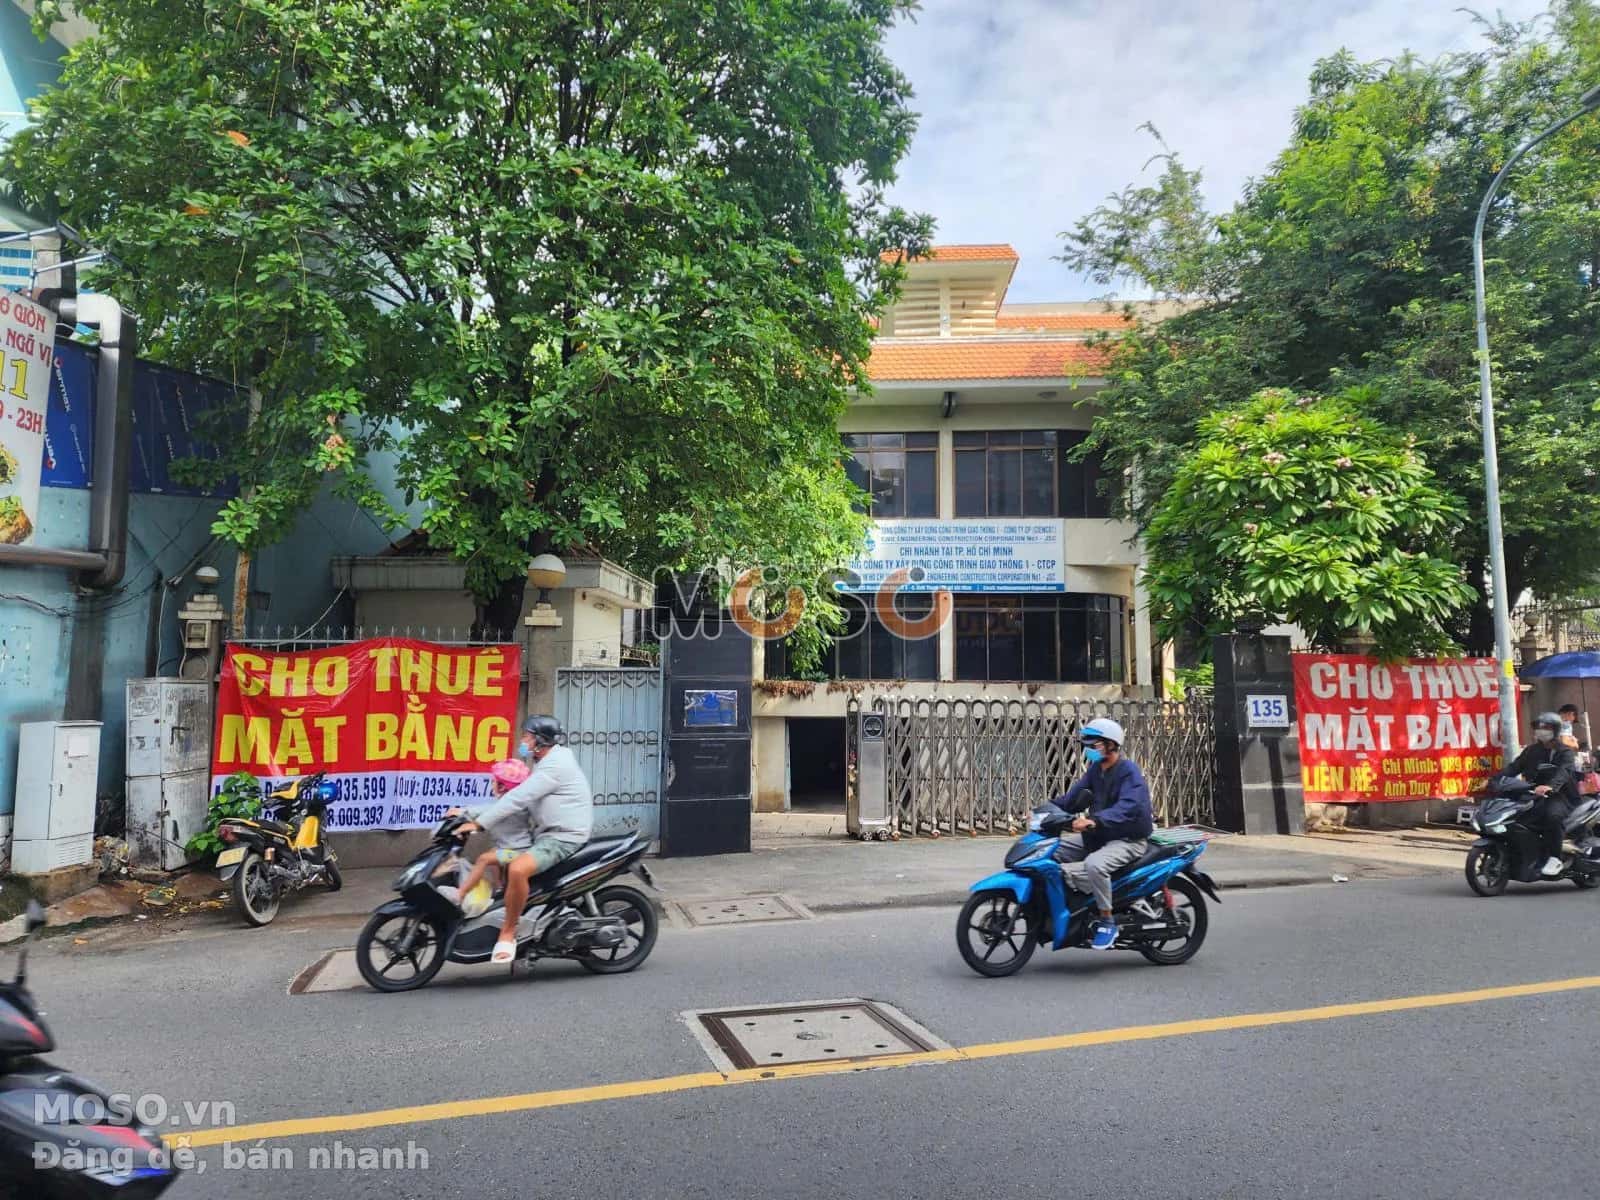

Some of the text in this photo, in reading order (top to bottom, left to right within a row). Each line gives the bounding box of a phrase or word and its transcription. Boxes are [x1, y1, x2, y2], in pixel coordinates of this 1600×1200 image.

[13, 303, 46, 333] GIÒN
[16, 407, 42, 434] 23H
[885, 560, 893, 569] TY
[979, 560, 997, 569] GIAO
[999, 558, 1023, 569] THÔNG
[1037, 560, 1057, 569] CTCP
[900, 546, 912, 556] CHI
[993, 547, 1013, 556] MINH
[232, 646, 504, 697] CHO THUÊ
[1309, 659, 1500, 700] CHO THUÊ
[1252, 699, 1283, 718] 135
[219, 694, 511, 776] MẶT BẰNG
[1304, 706, 1395, 760] MẶT
[1303, 760, 1345, 792] LIÊN
[1404, 755, 1439, 775] Minh:
[1384, 780, 1407, 797] Anh
[1409, 780, 1431, 797] Duy
